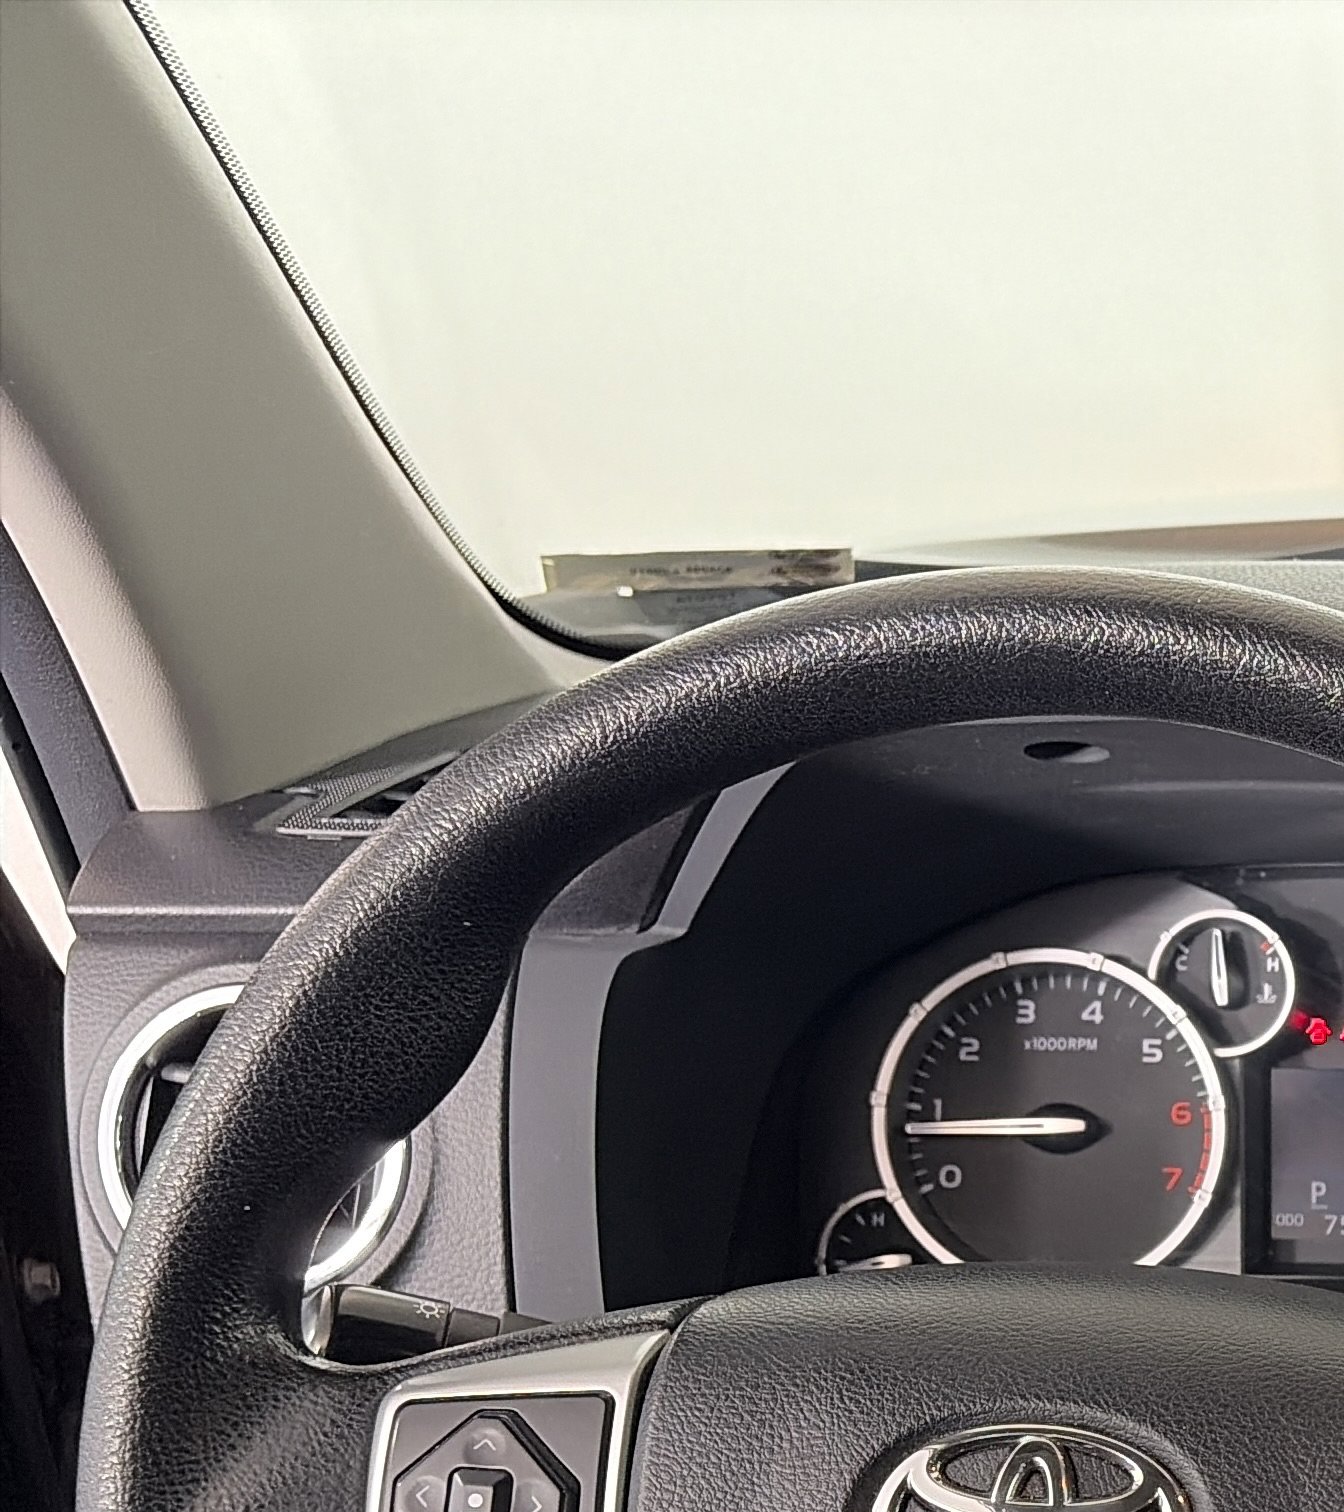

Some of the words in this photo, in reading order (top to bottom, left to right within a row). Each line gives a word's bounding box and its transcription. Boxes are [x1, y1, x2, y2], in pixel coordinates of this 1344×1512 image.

[1175, 955, 1188, 971] C
[1266, 957, 1280, 973] H
[1014, 1000, 1036, 1025] 3
[1081, 1000, 1104, 1025] 4
[958, 1038, 981, 1062] 2
[1141, 1038, 1164, 1063] 5
[933, 1099, 943, 1121] 1
[1170, 1102, 1192, 1125] 6
[938, 1165, 962, 1188] 0
[1161, 1167, 1184, 1191] 7
[1310, 1181, 1327, 1203] P
